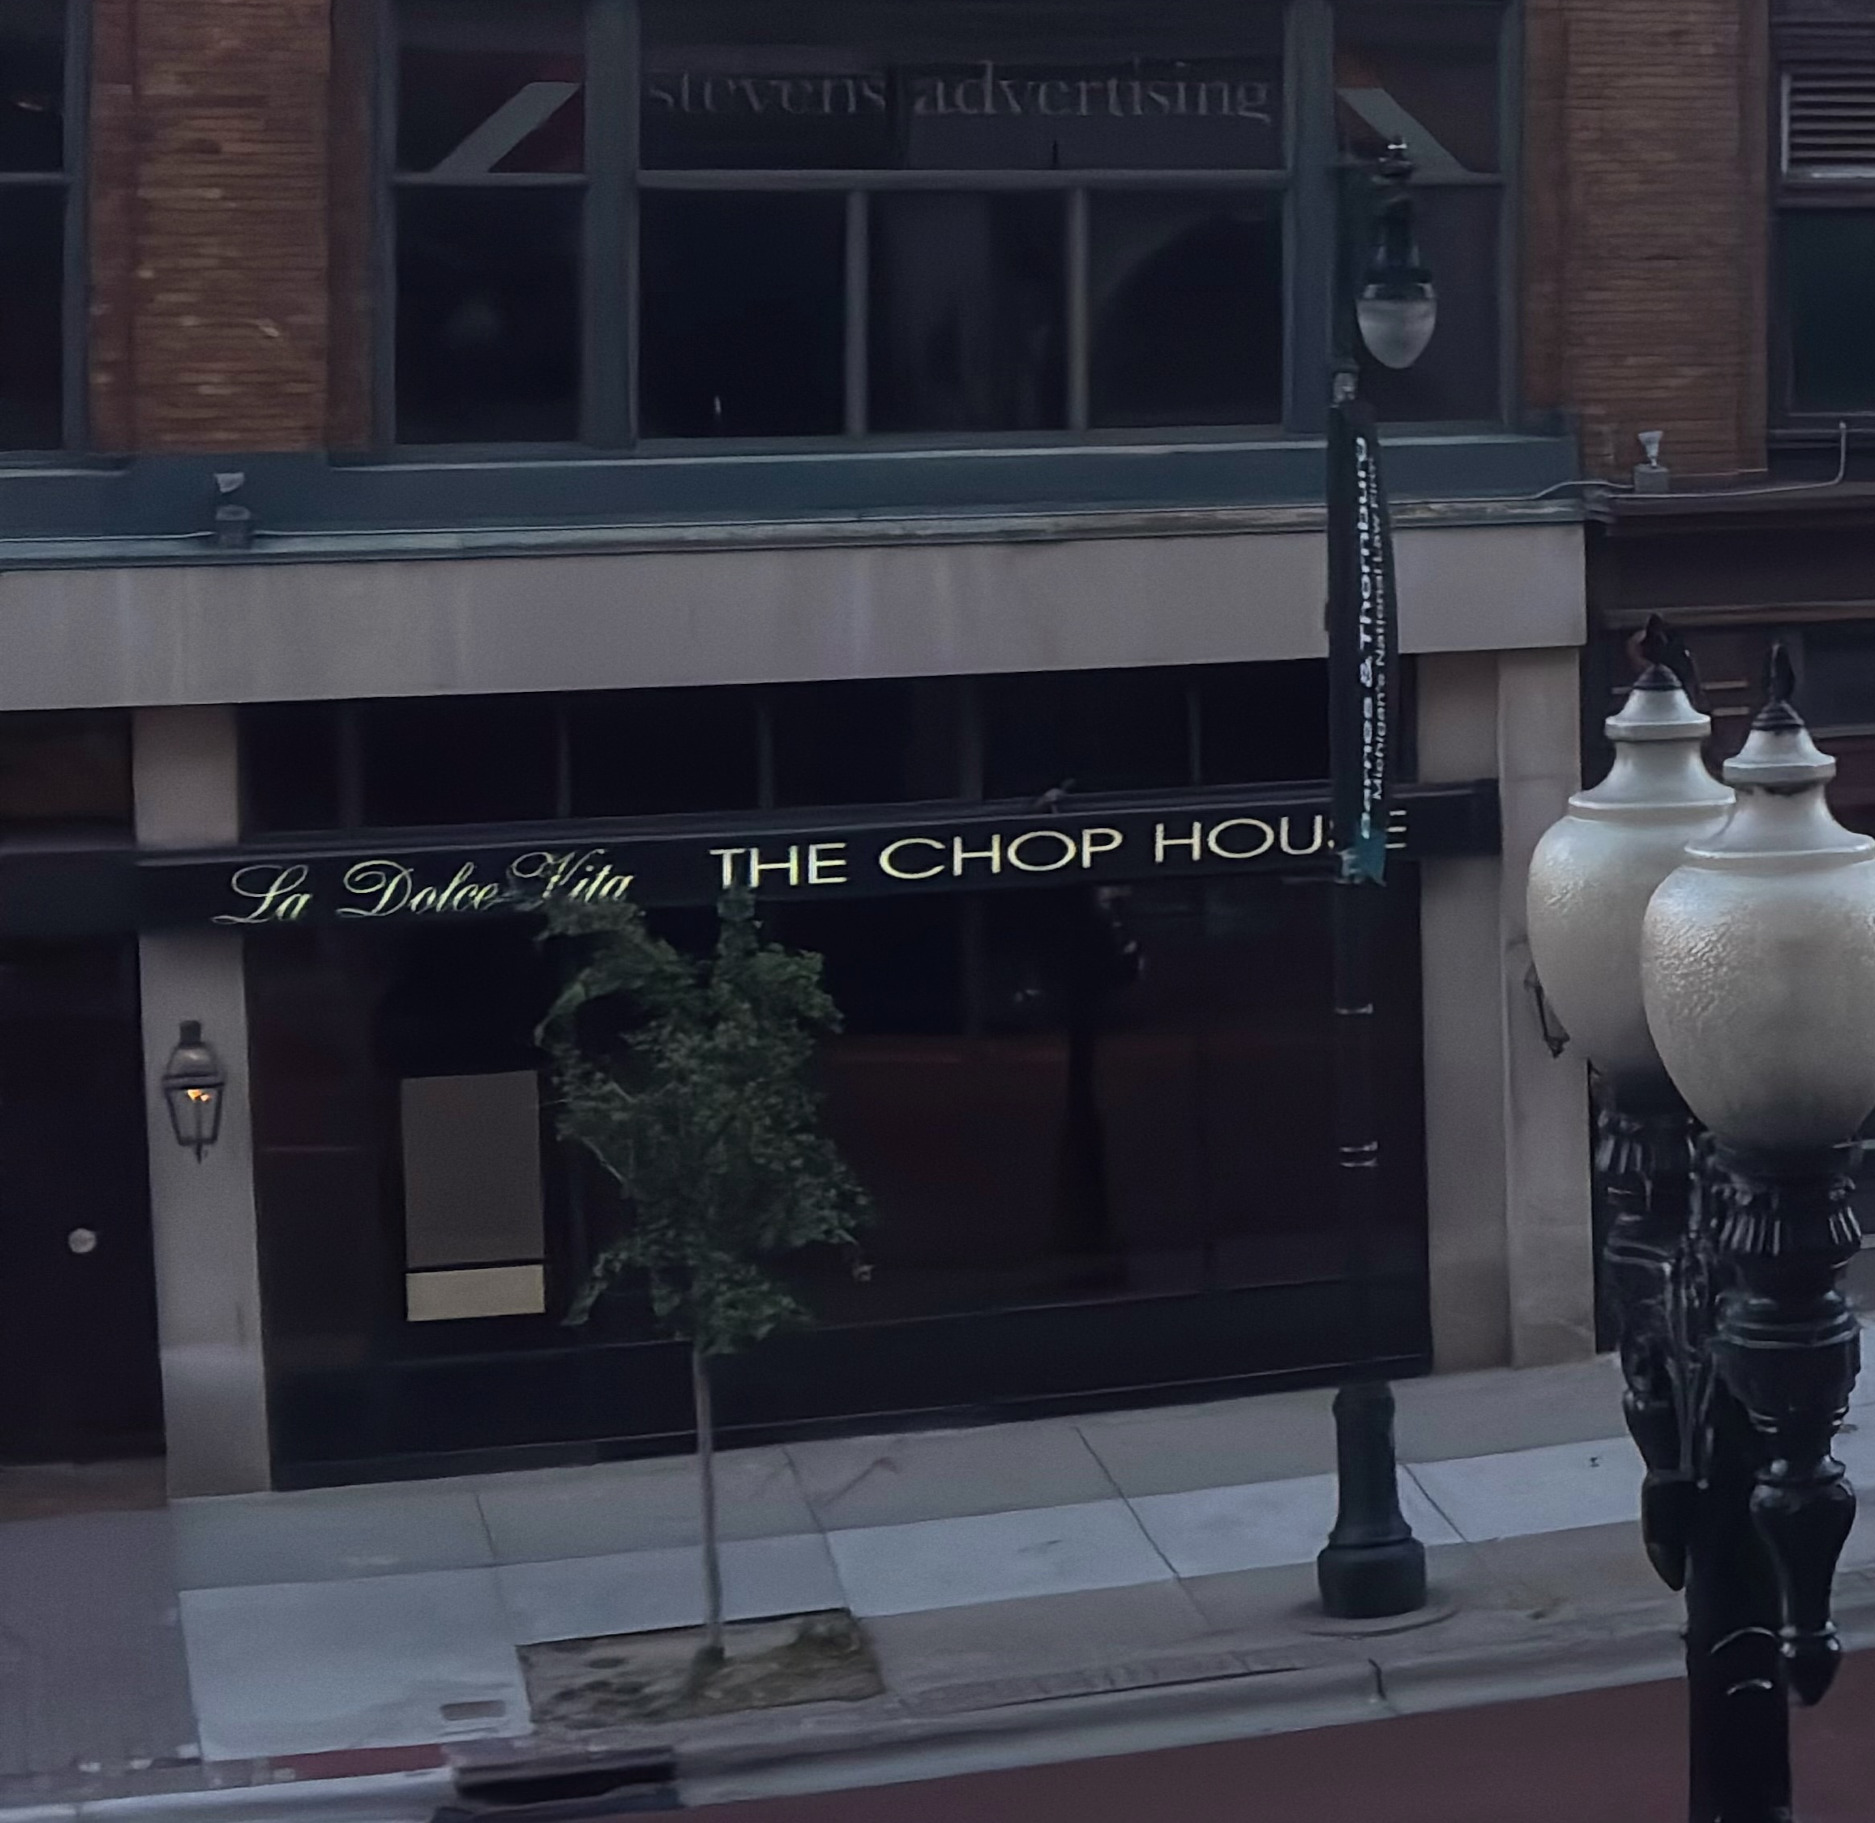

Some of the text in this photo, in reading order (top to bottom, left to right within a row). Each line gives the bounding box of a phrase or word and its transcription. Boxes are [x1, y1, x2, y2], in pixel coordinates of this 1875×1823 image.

[648, 59, 1273, 124] stevens advertising
[1359, 655, 1373, 687] &
[710, 809, 1407, 888] THE CHOP HOUE
[211, 847, 635, 925] La Dolce Vita
